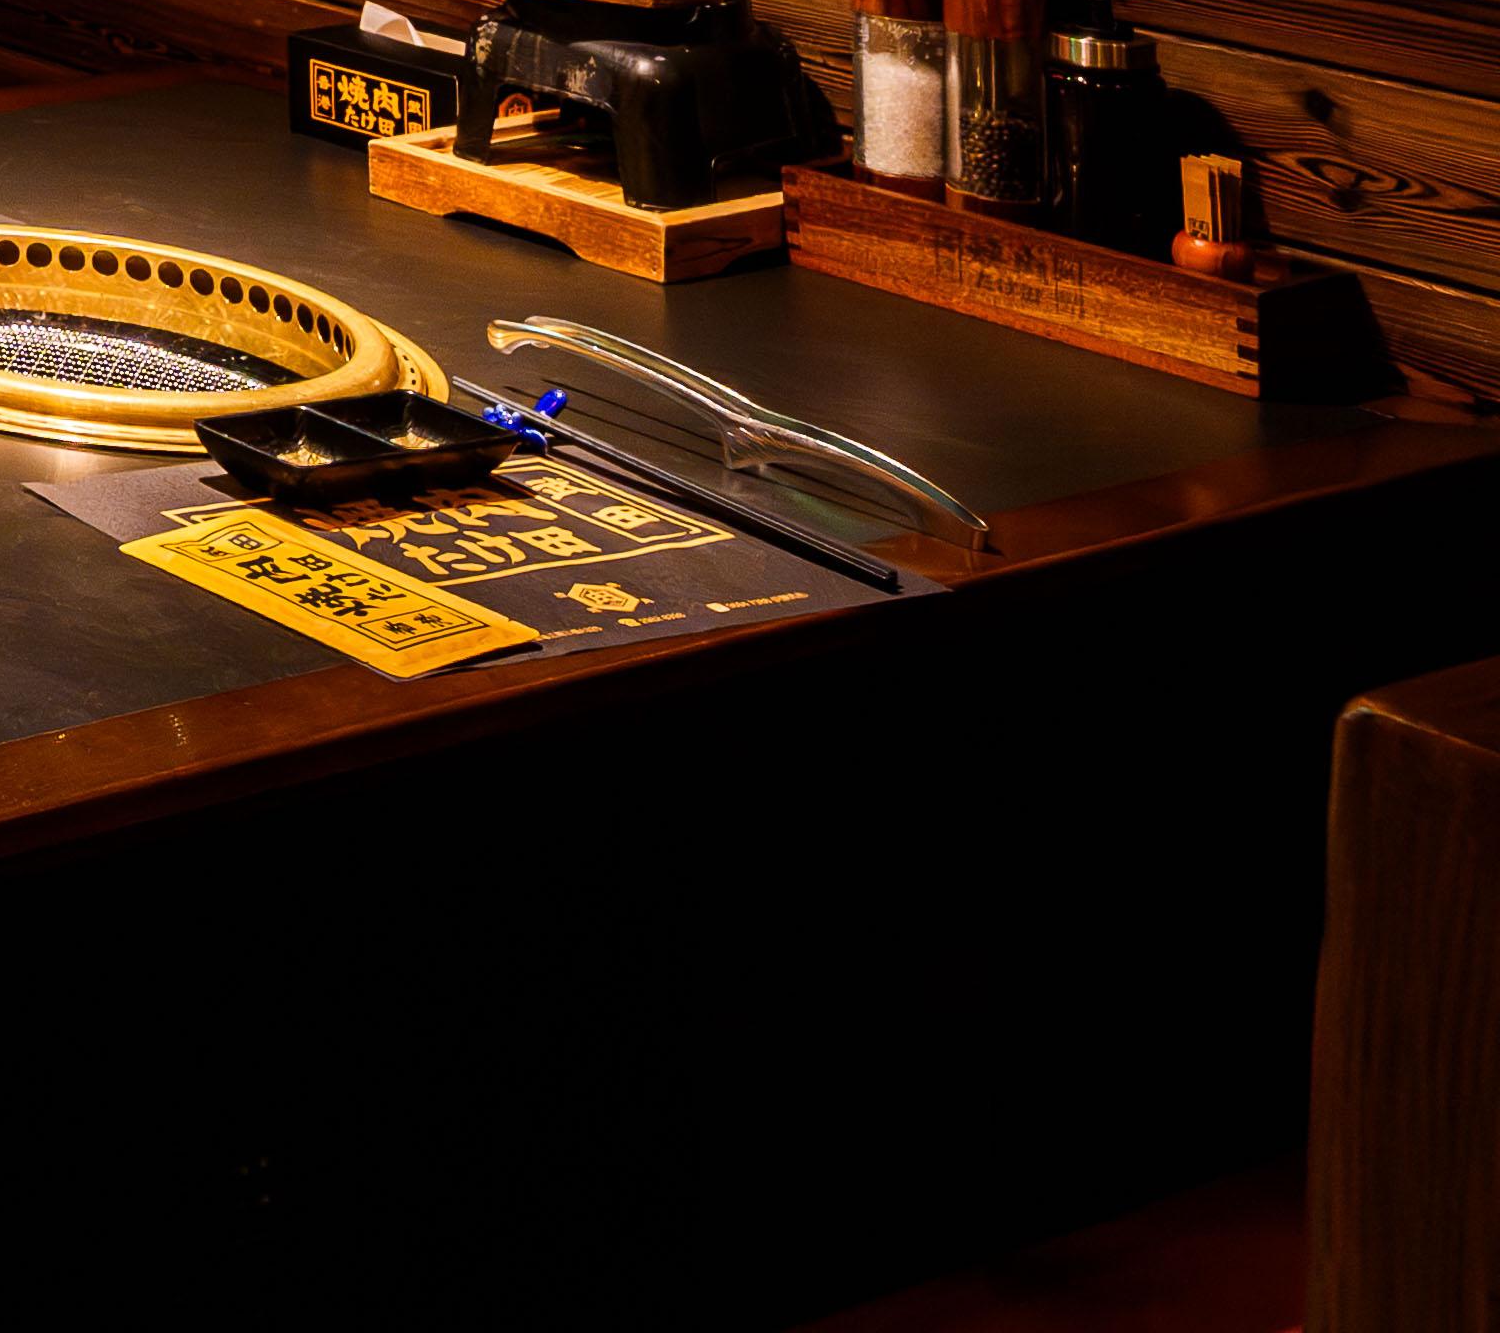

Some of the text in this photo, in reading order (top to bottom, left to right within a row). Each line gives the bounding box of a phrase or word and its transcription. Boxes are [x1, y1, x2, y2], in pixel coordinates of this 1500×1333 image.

[337, 74, 402, 120] 焼肉
[344, 105, 396, 137] たけ田
[399, 525, 603, 576] たけ田
[235, 554, 381, 619] 焼肉
[286, 552, 408, 603] たけ田
